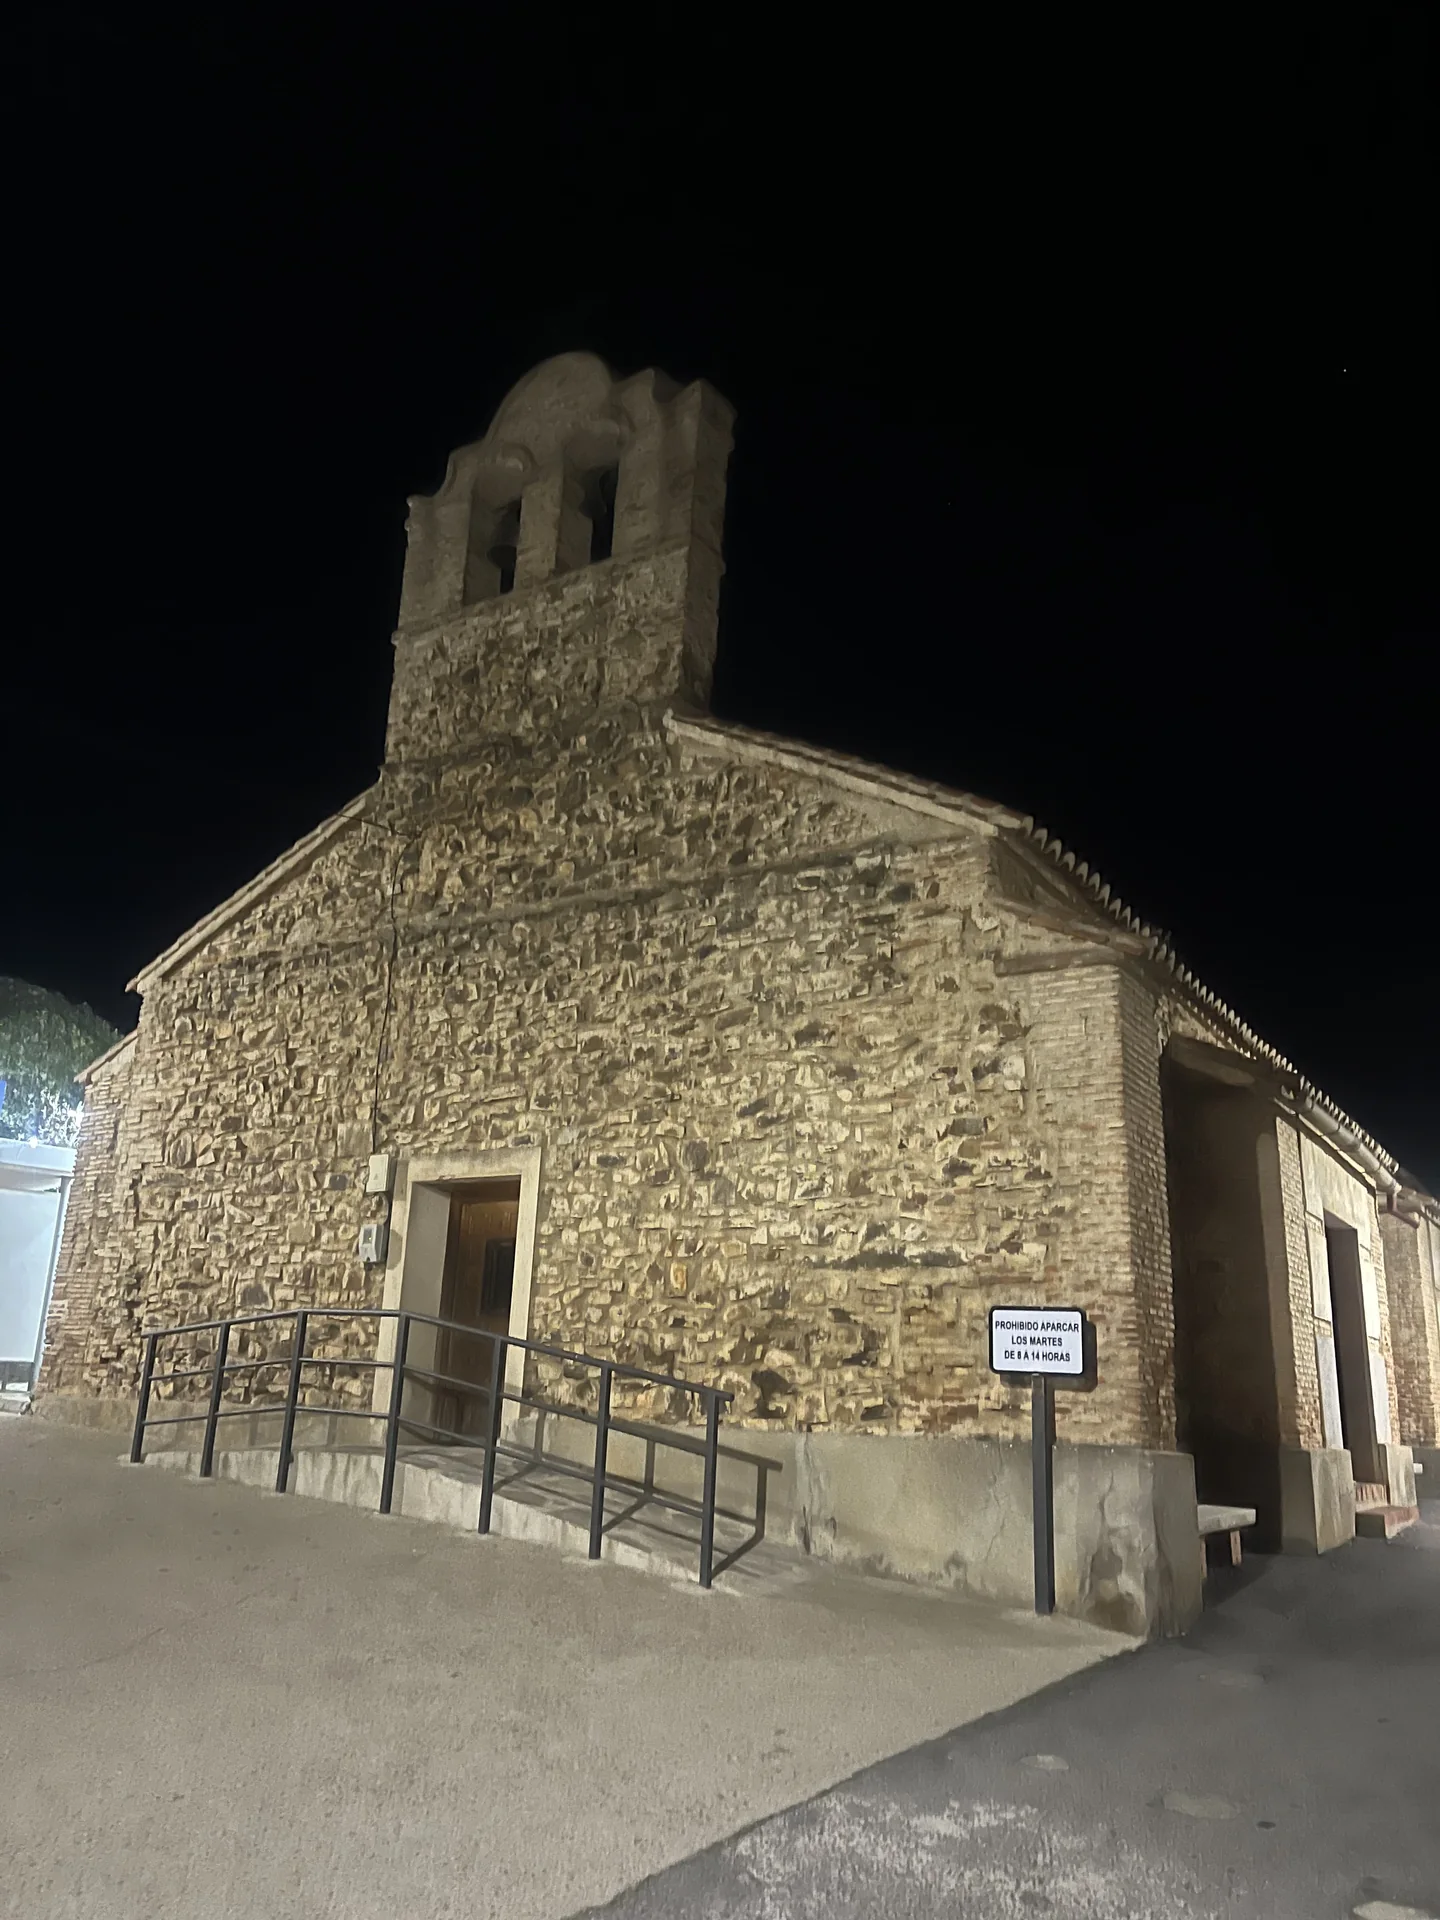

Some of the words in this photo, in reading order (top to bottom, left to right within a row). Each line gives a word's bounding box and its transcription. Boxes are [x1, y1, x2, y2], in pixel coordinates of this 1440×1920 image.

[995, 1321, 1039, 1331] PROHIBIDO
[1040, 1322, 1079, 1332] APARCAR
[1012, 1335, 1027, 1345] LOS
[1030, 1336, 1062, 1346] MARTES
[1005, 1350, 1015, 1359] DE
[1024, 1351, 1029, 1360] A
[1031, 1351, 1040, 1360] 14
[1042, 1352, 1070, 1361] HORAS
